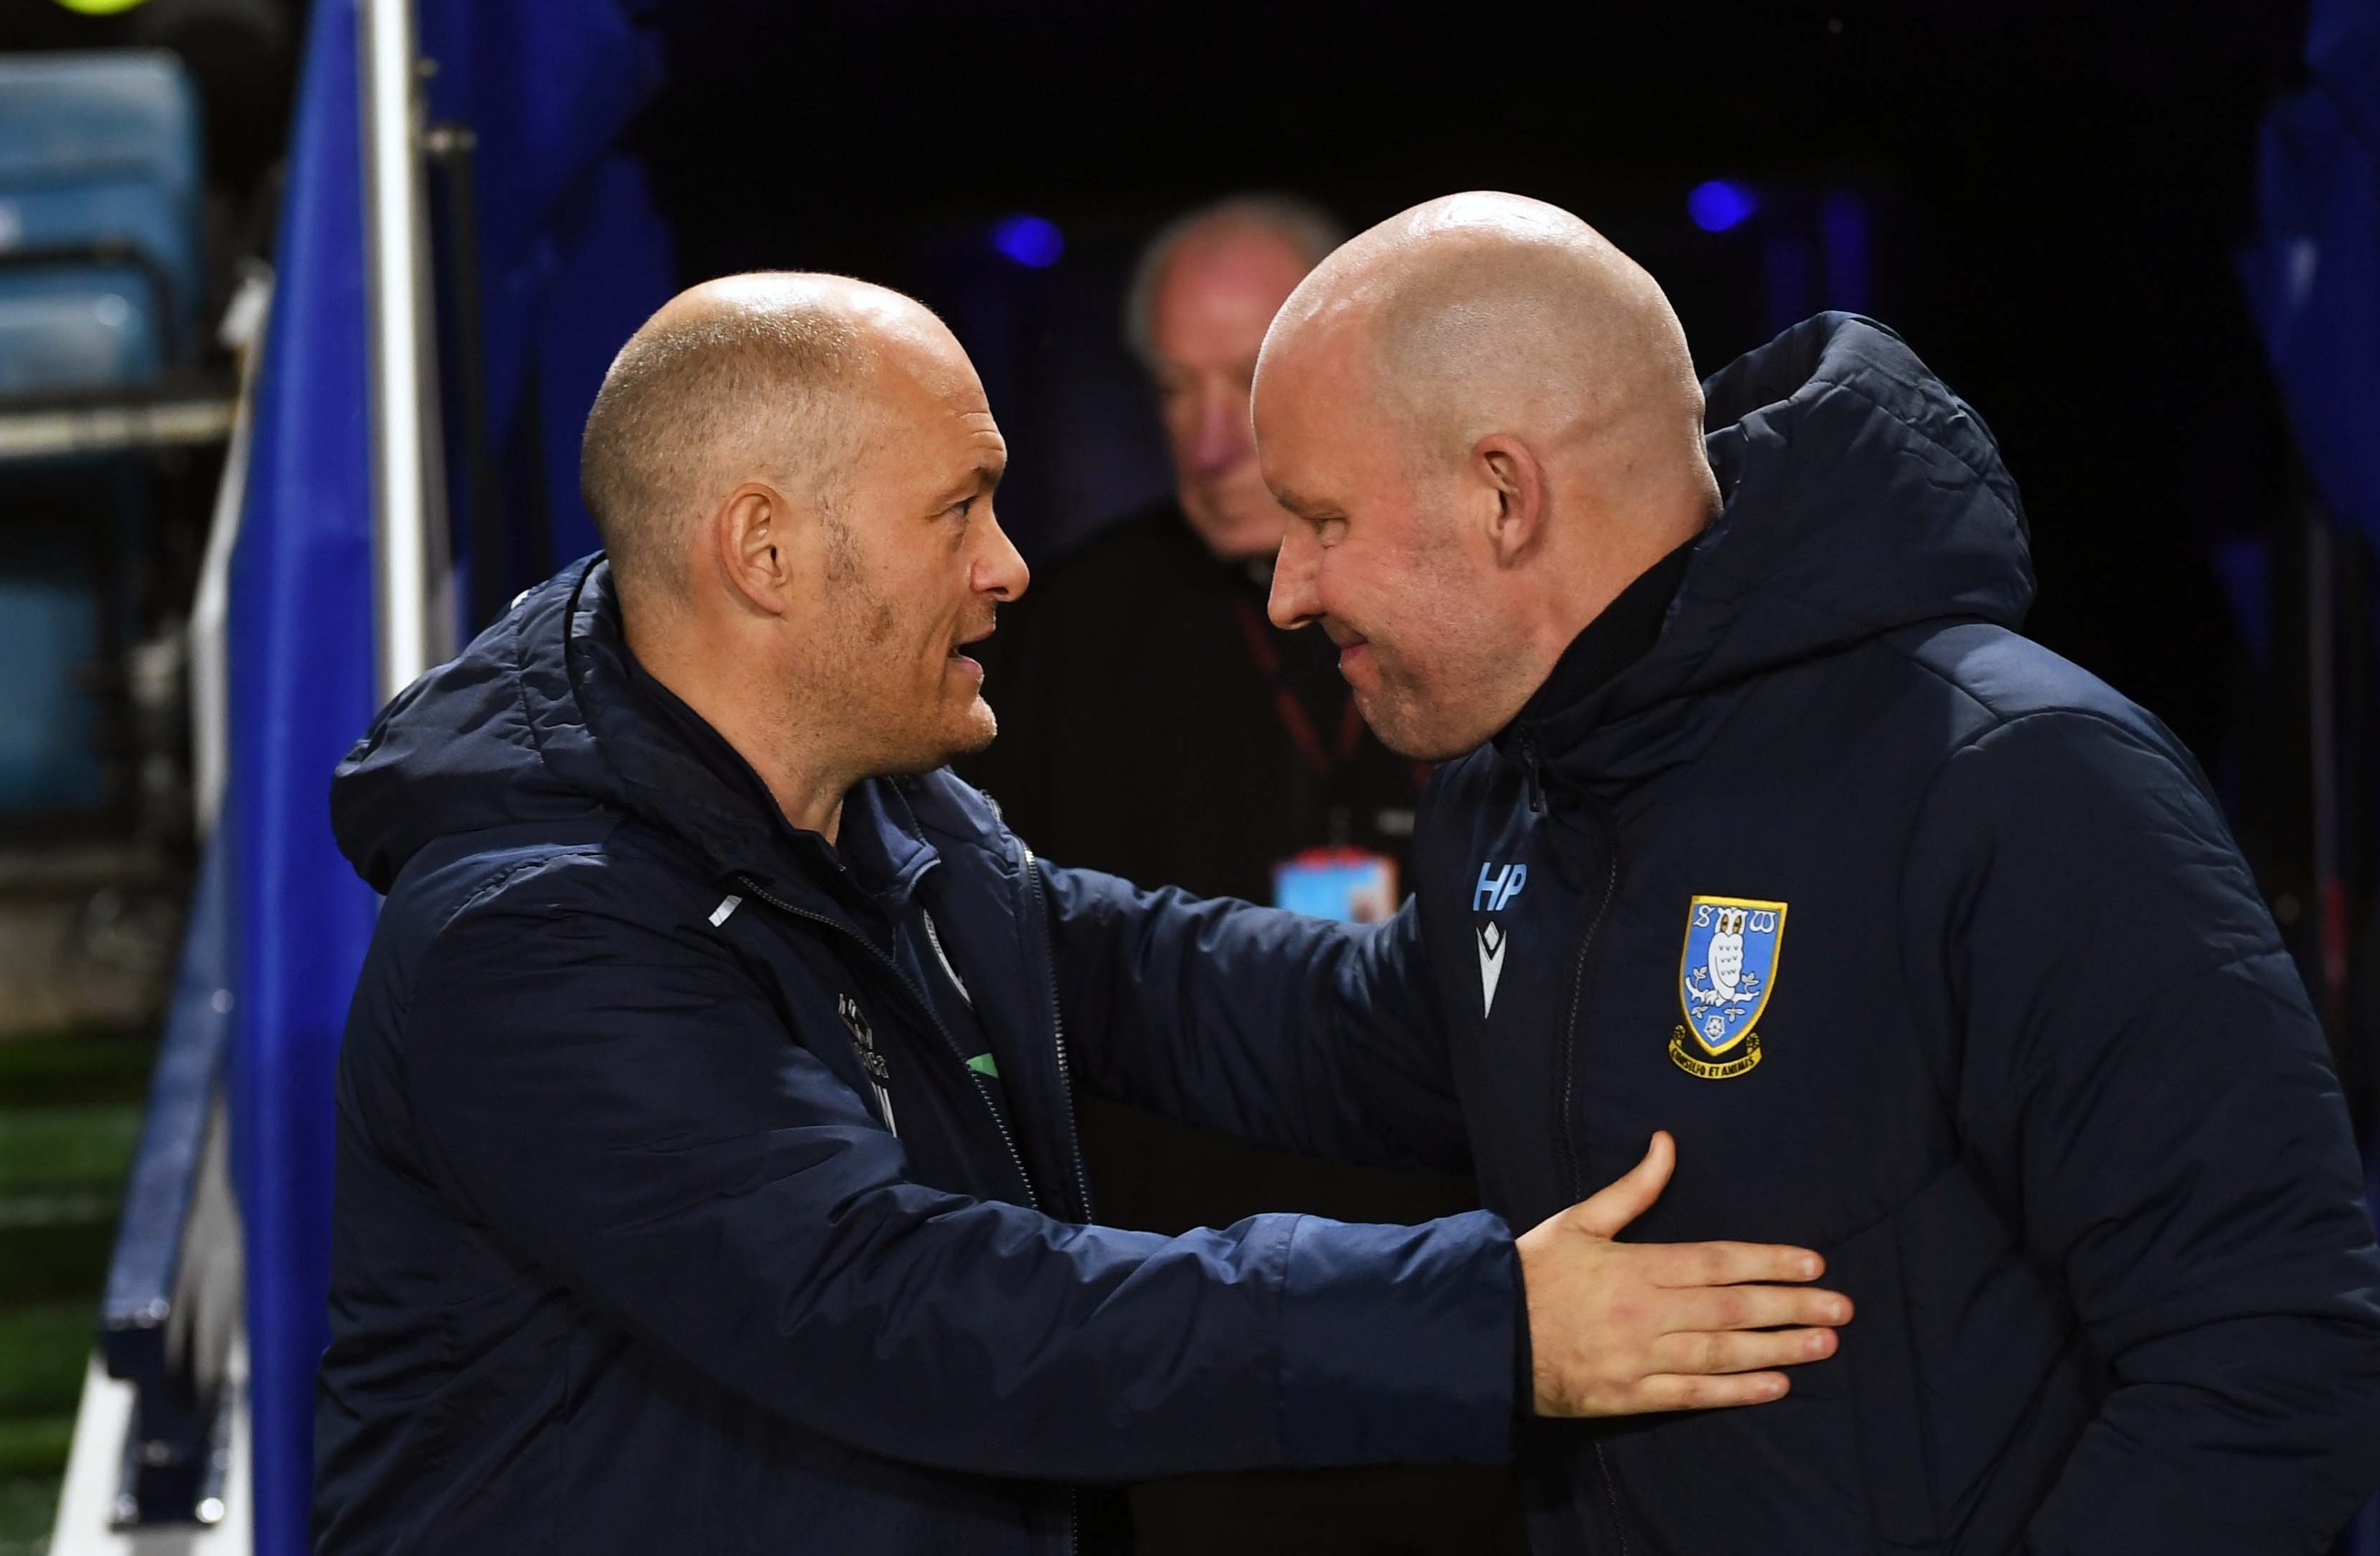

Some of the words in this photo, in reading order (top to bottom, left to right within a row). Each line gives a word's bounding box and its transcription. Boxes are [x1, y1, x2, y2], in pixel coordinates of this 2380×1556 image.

[1473, 862, 1527, 911] HP
[1693, 904, 1715, 928] S
[1750, 909, 1777, 933] W
[1709, 1066, 1720, 1076] ET
